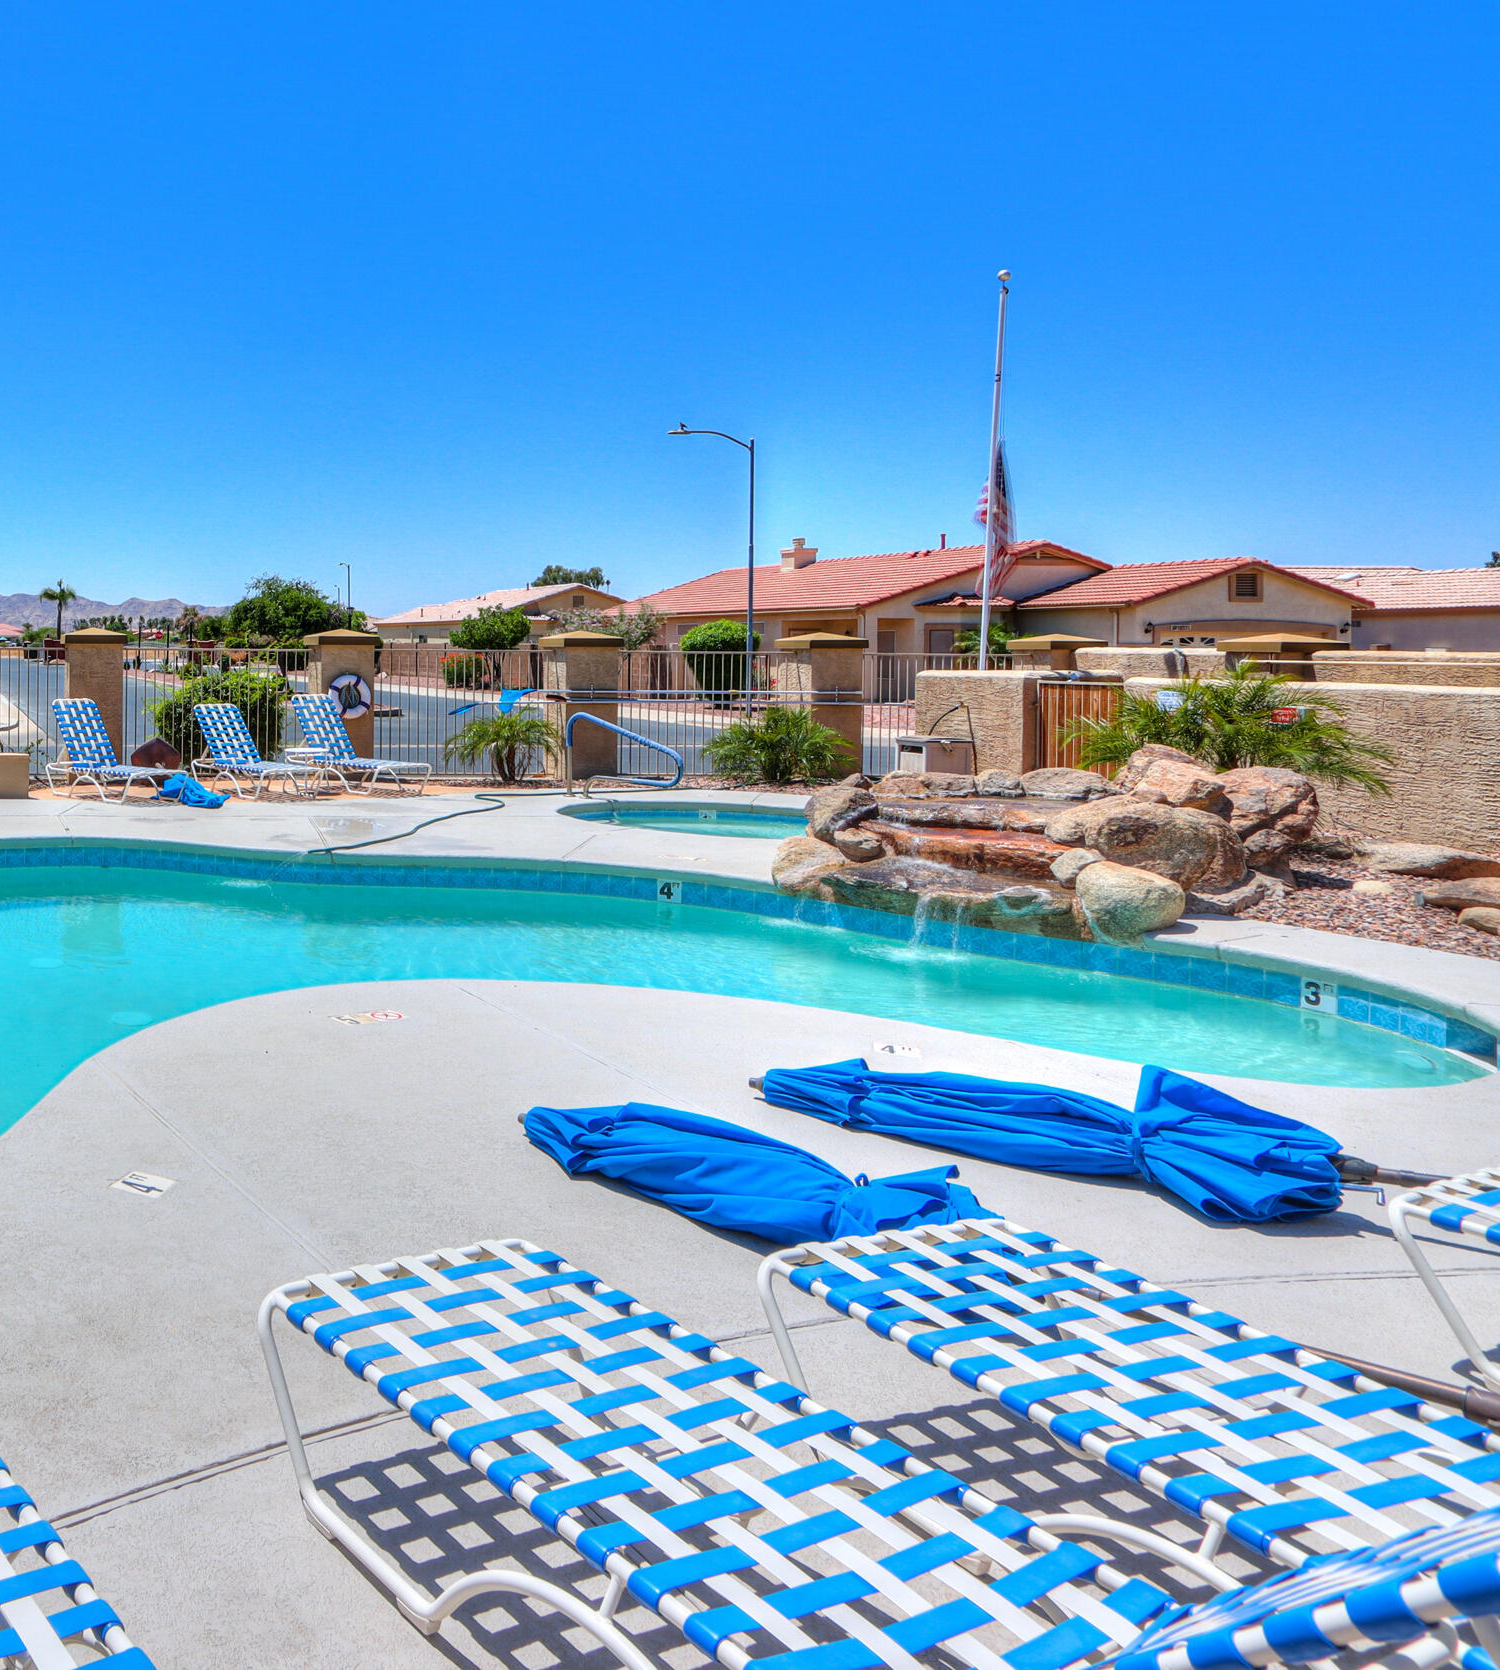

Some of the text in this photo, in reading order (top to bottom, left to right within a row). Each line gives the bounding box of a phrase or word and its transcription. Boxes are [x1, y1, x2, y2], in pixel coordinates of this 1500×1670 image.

[660, 882, 673, 899] 4
[1305, 982, 1321, 1006] 3
[121, 1180, 164, 1193] 4
